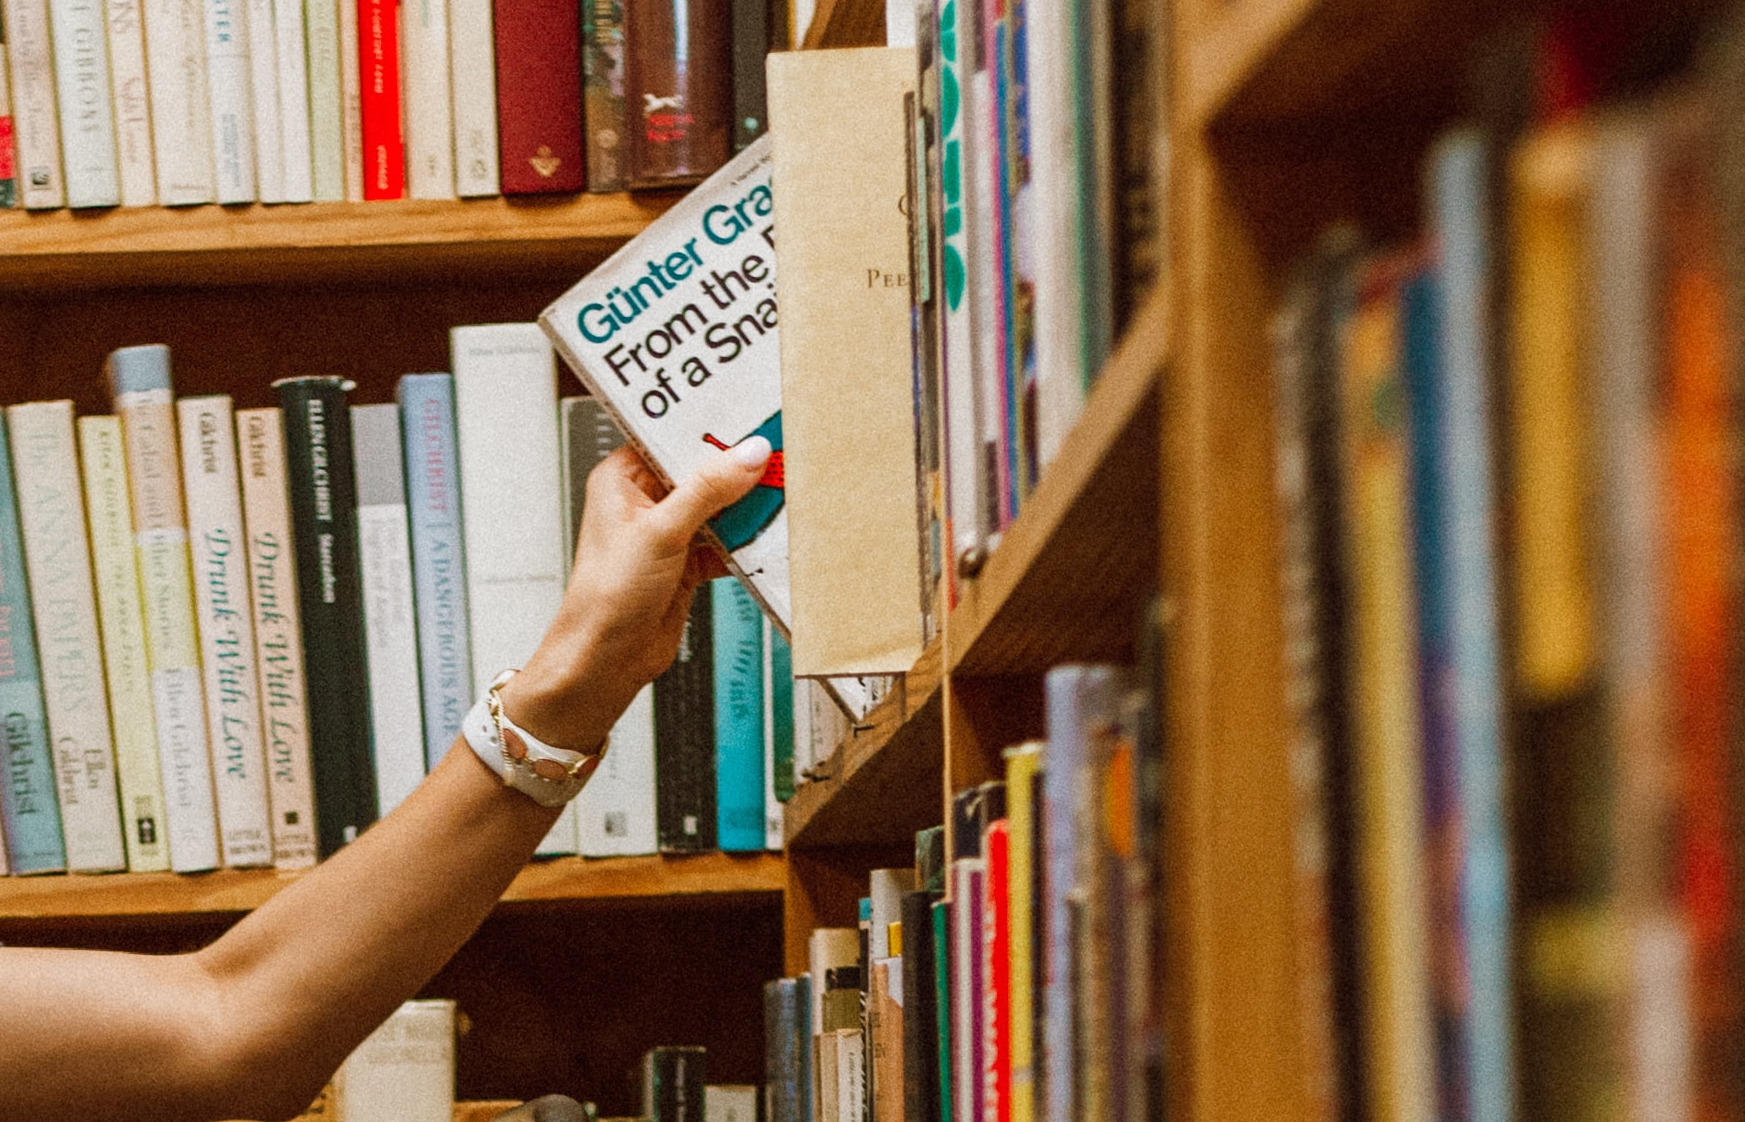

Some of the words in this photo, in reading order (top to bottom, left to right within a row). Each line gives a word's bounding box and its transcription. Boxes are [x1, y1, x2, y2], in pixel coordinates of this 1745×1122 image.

[576, 236, 704, 345] Günter
[701, 178, 774, 246] Gra
[602, 298, 709, 387] From
[701, 248, 770, 312] the
[639, 373, 680, 421] of
[679, 355, 713, 389] a
[704, 283, 780, 365] Sna
[197, 411, 219, 475] Gilchrist
[246, 415, 268, 479] Gilchrist
[202, 527, 241, 625] Drunk
[251, 532, 288, 626] Drunk
[431, 539, 448, 554] A
[434, 558, 457, 690] DANGEROUS
[214, 628, 248, 706] With
[261, 631, 296, 709] With
[219, 711, 251, 781] Love
[269, 715, 300, 785] Love
[442, 693, 461, 737] AGE
[2, 711, 43, 816] Gilchrist
[82, 747, 103, 790] Ellen
